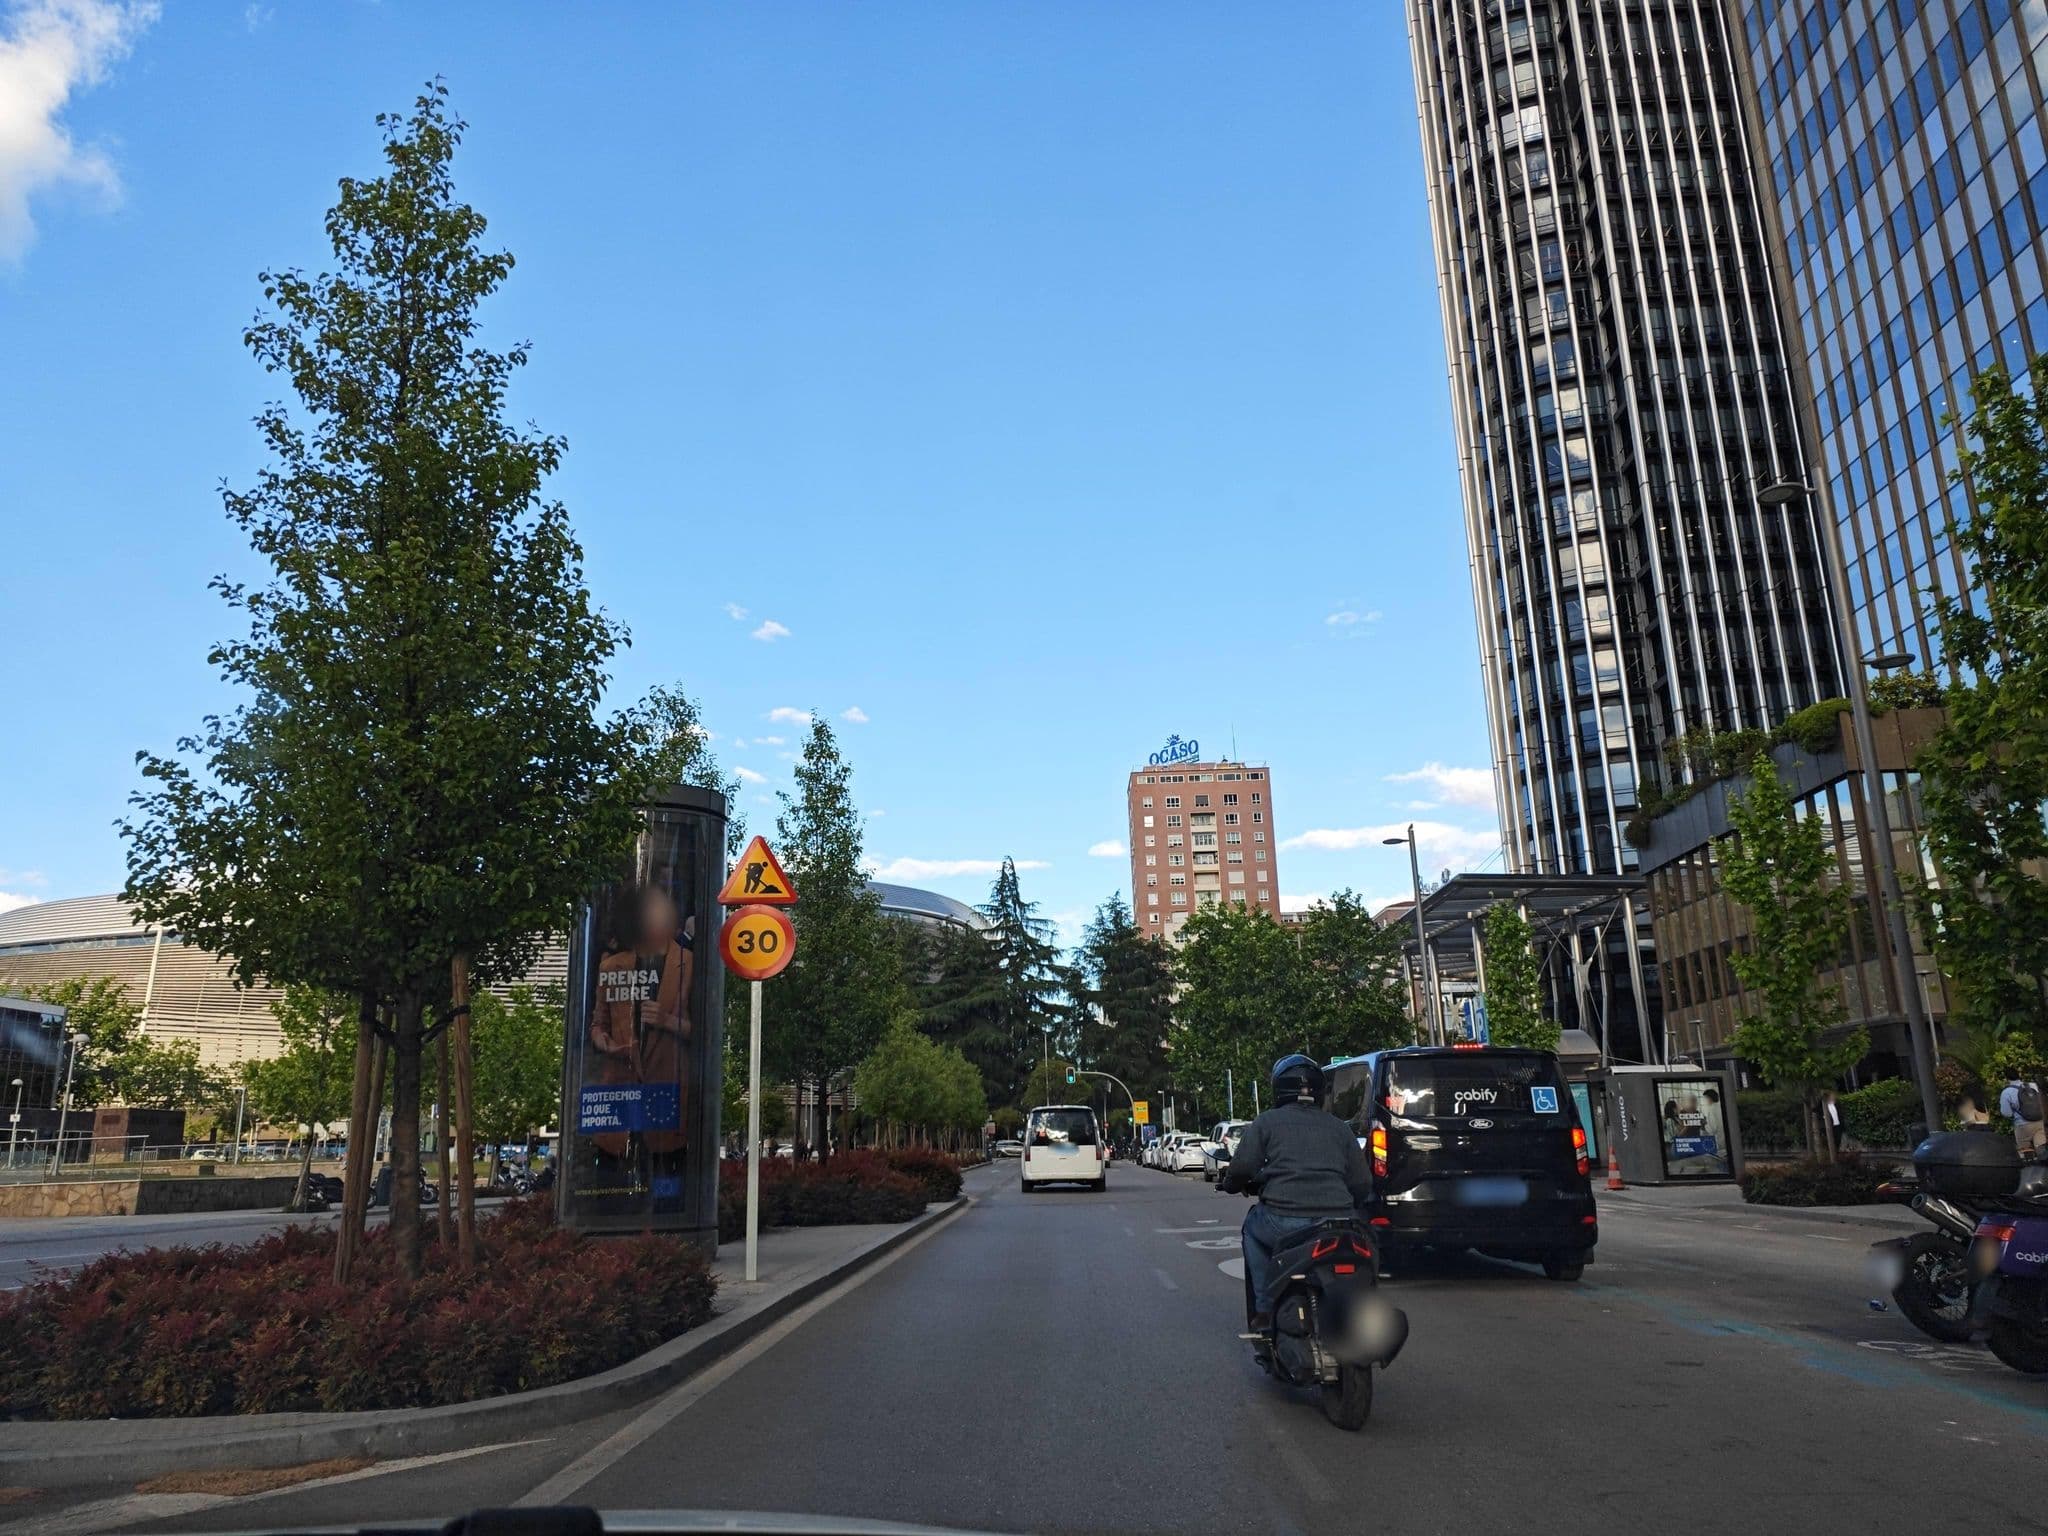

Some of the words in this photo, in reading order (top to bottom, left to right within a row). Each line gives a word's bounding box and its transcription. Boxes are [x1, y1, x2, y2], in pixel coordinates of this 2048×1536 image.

[1149, 740, 1199, 765] OCASO
[737, 930, 778, 954] 30
[599, 970, 659, 986] PRENSA
[606, 986, 651, 1003] LIBRE
[582, 1091, 642, 1103] PROTEGEMOS
[1454, 1088, 1497, 1104] cabify
[582, 1105, 592, 1115] LO
[593, 1104, 610, 1114] QUE
